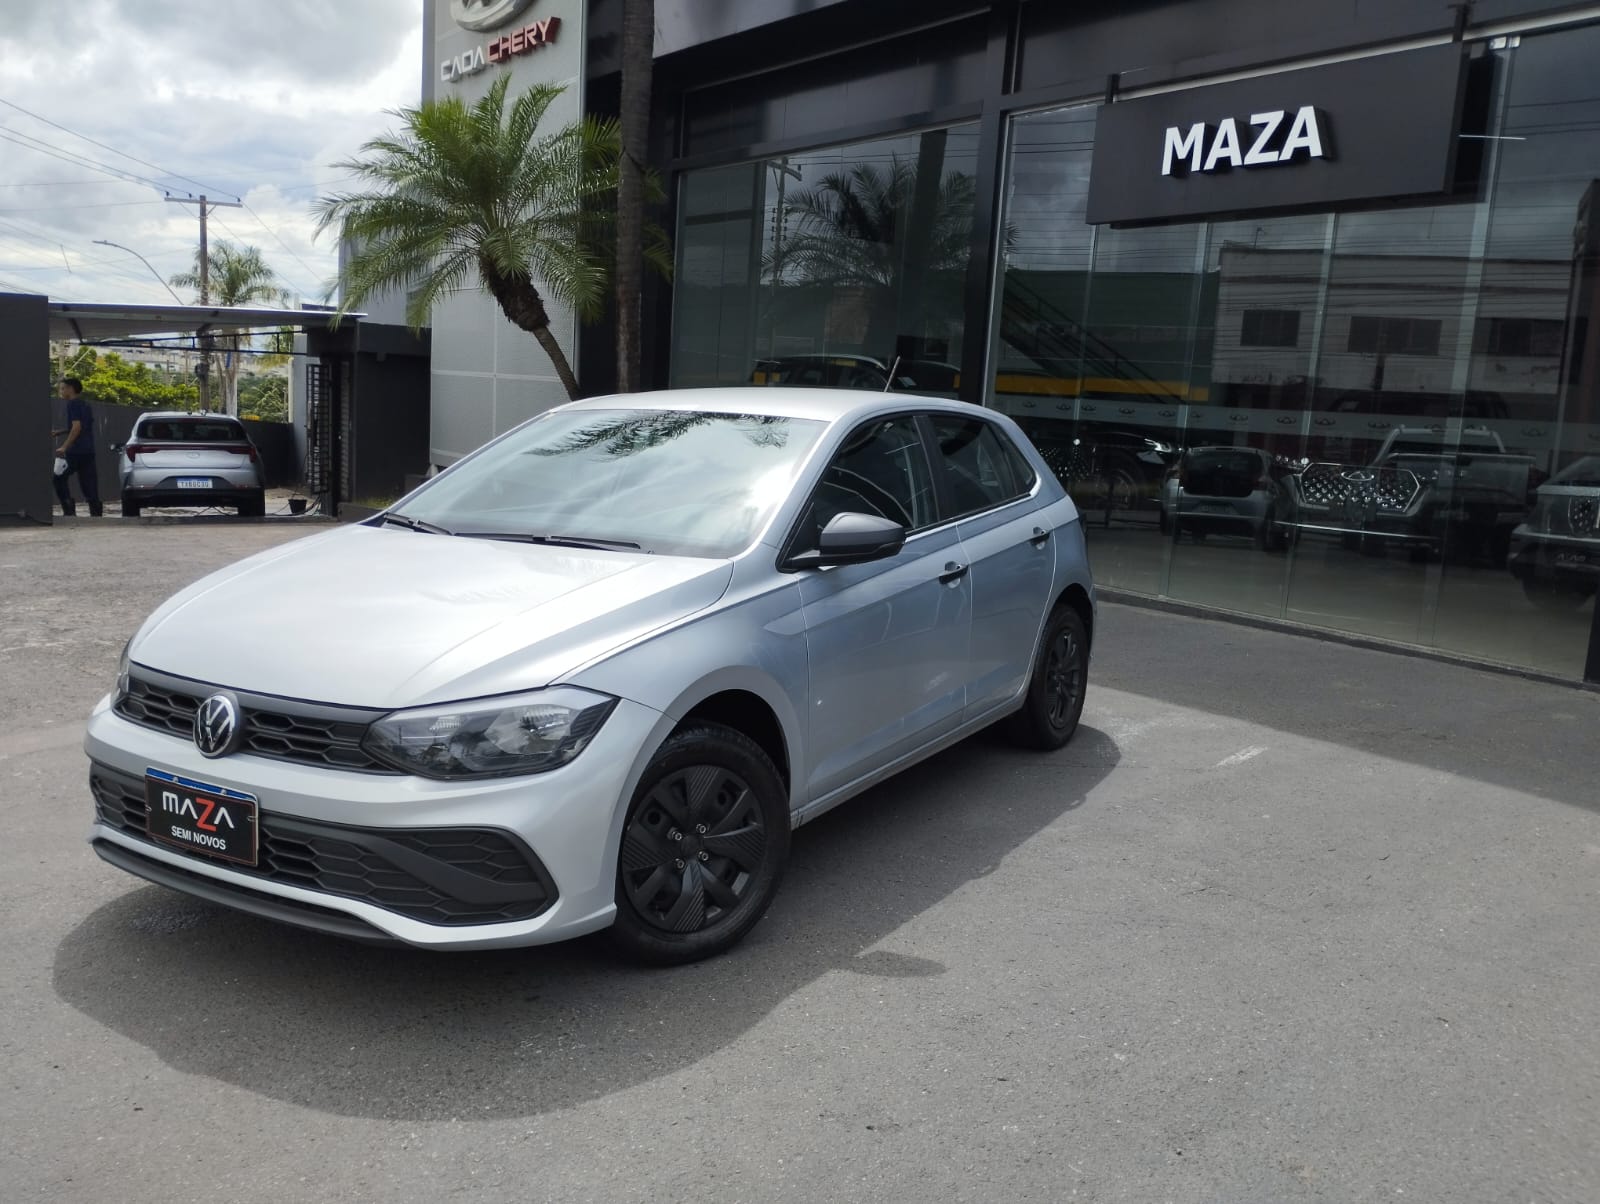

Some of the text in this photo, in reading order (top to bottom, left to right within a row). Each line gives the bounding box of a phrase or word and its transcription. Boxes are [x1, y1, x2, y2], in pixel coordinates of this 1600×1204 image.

[487, 16, 555, 65] CHERY
[1161, 105, 1323, 176] MAZA
[162, 791, 235, 832] MAZA
[171, 825, 227, 850] SEMI NOVOS
